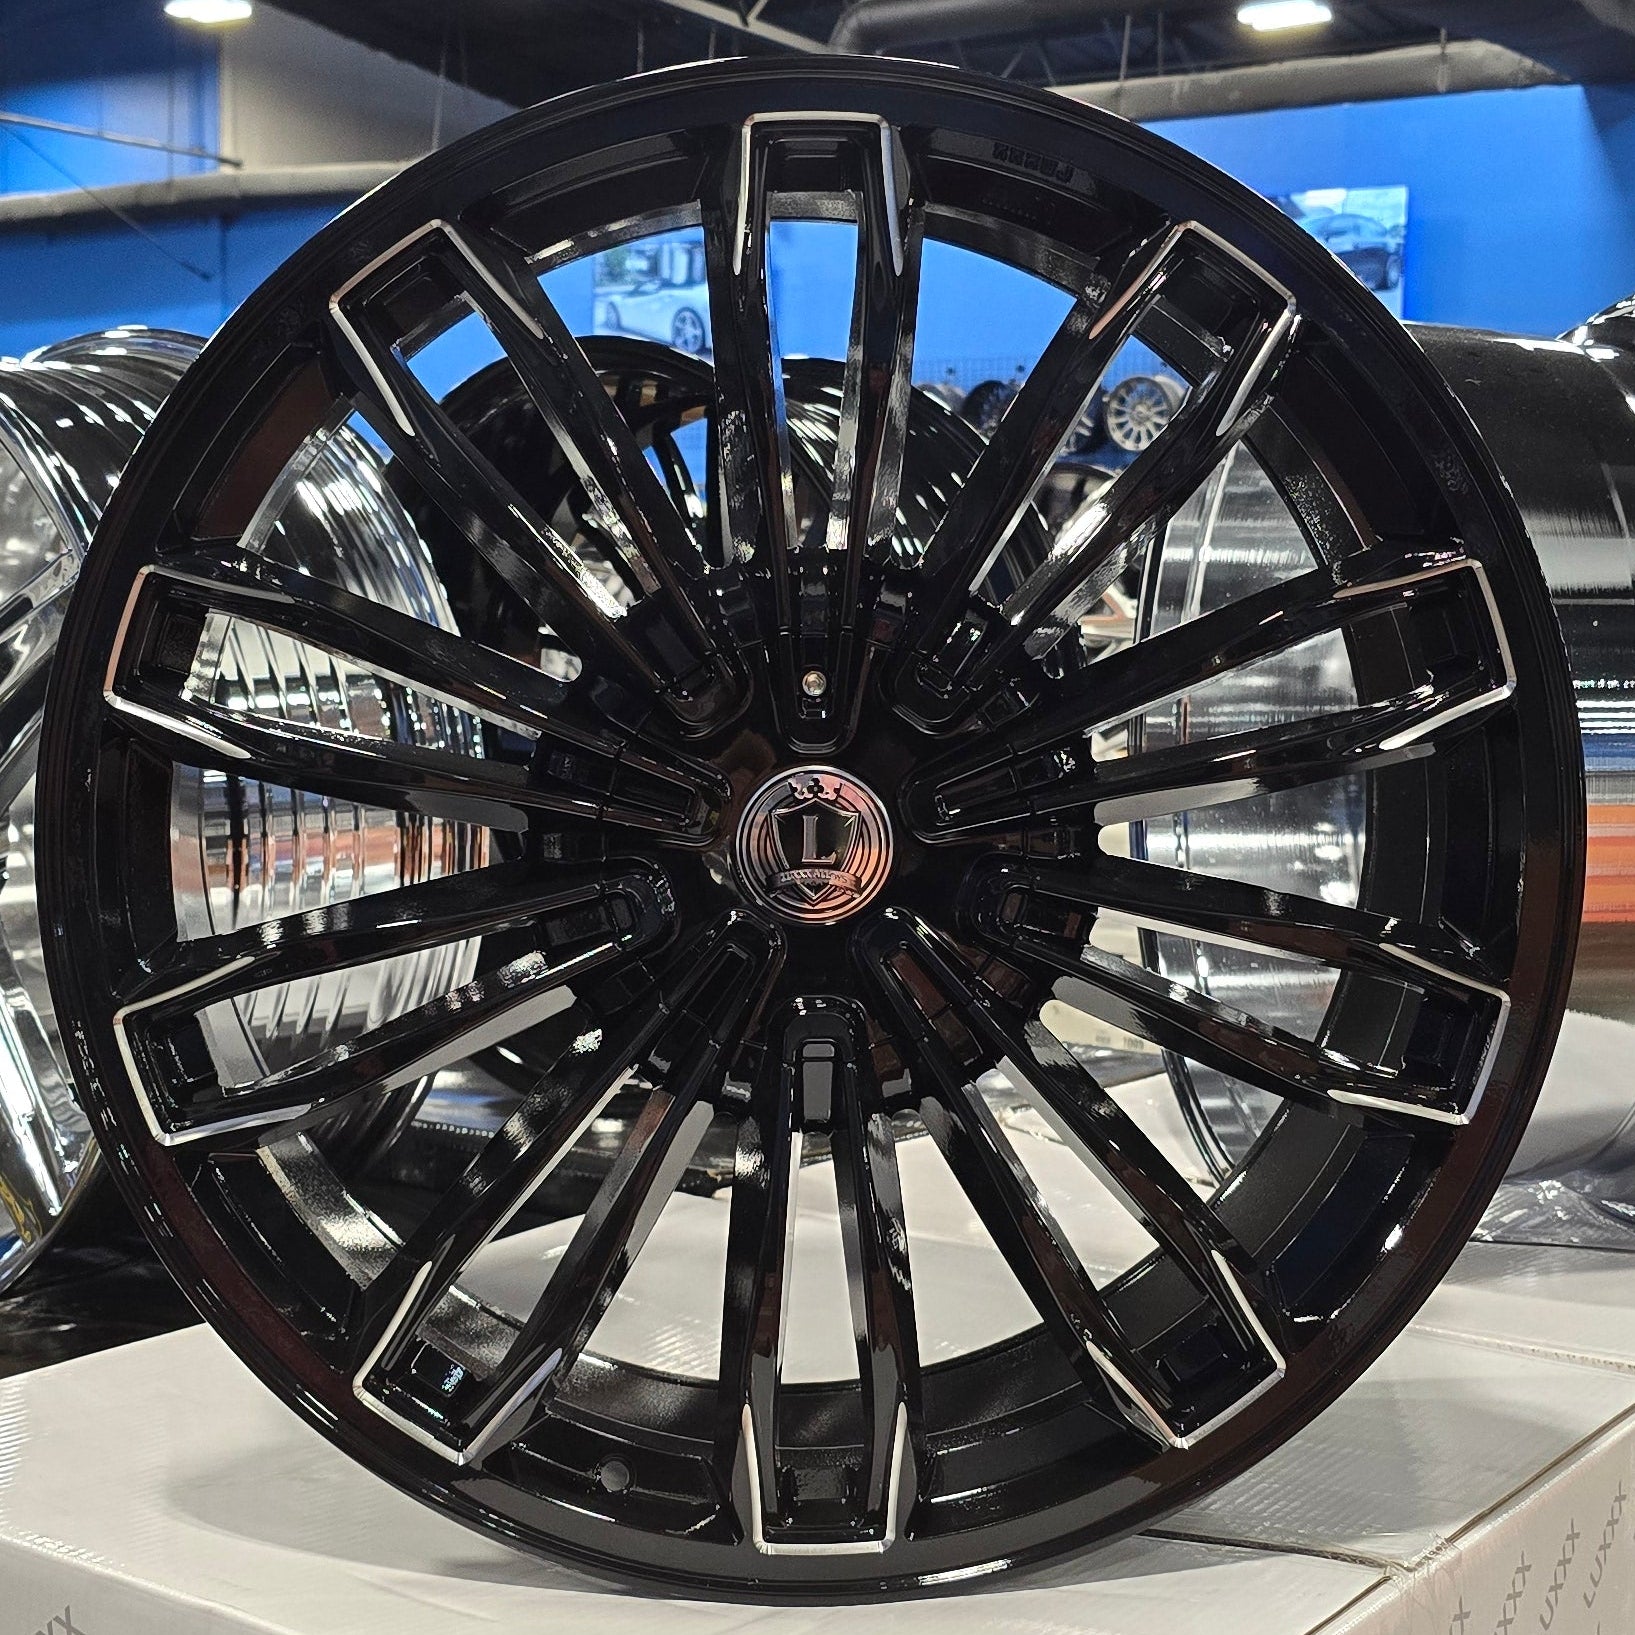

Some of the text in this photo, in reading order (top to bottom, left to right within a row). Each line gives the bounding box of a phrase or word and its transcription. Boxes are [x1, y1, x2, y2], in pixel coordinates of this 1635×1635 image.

[801, 815, 837, 865] L
[1583, 1480, 1627, 1609] LUXXX
[1494, 1550, 1532, 1635] XXX
